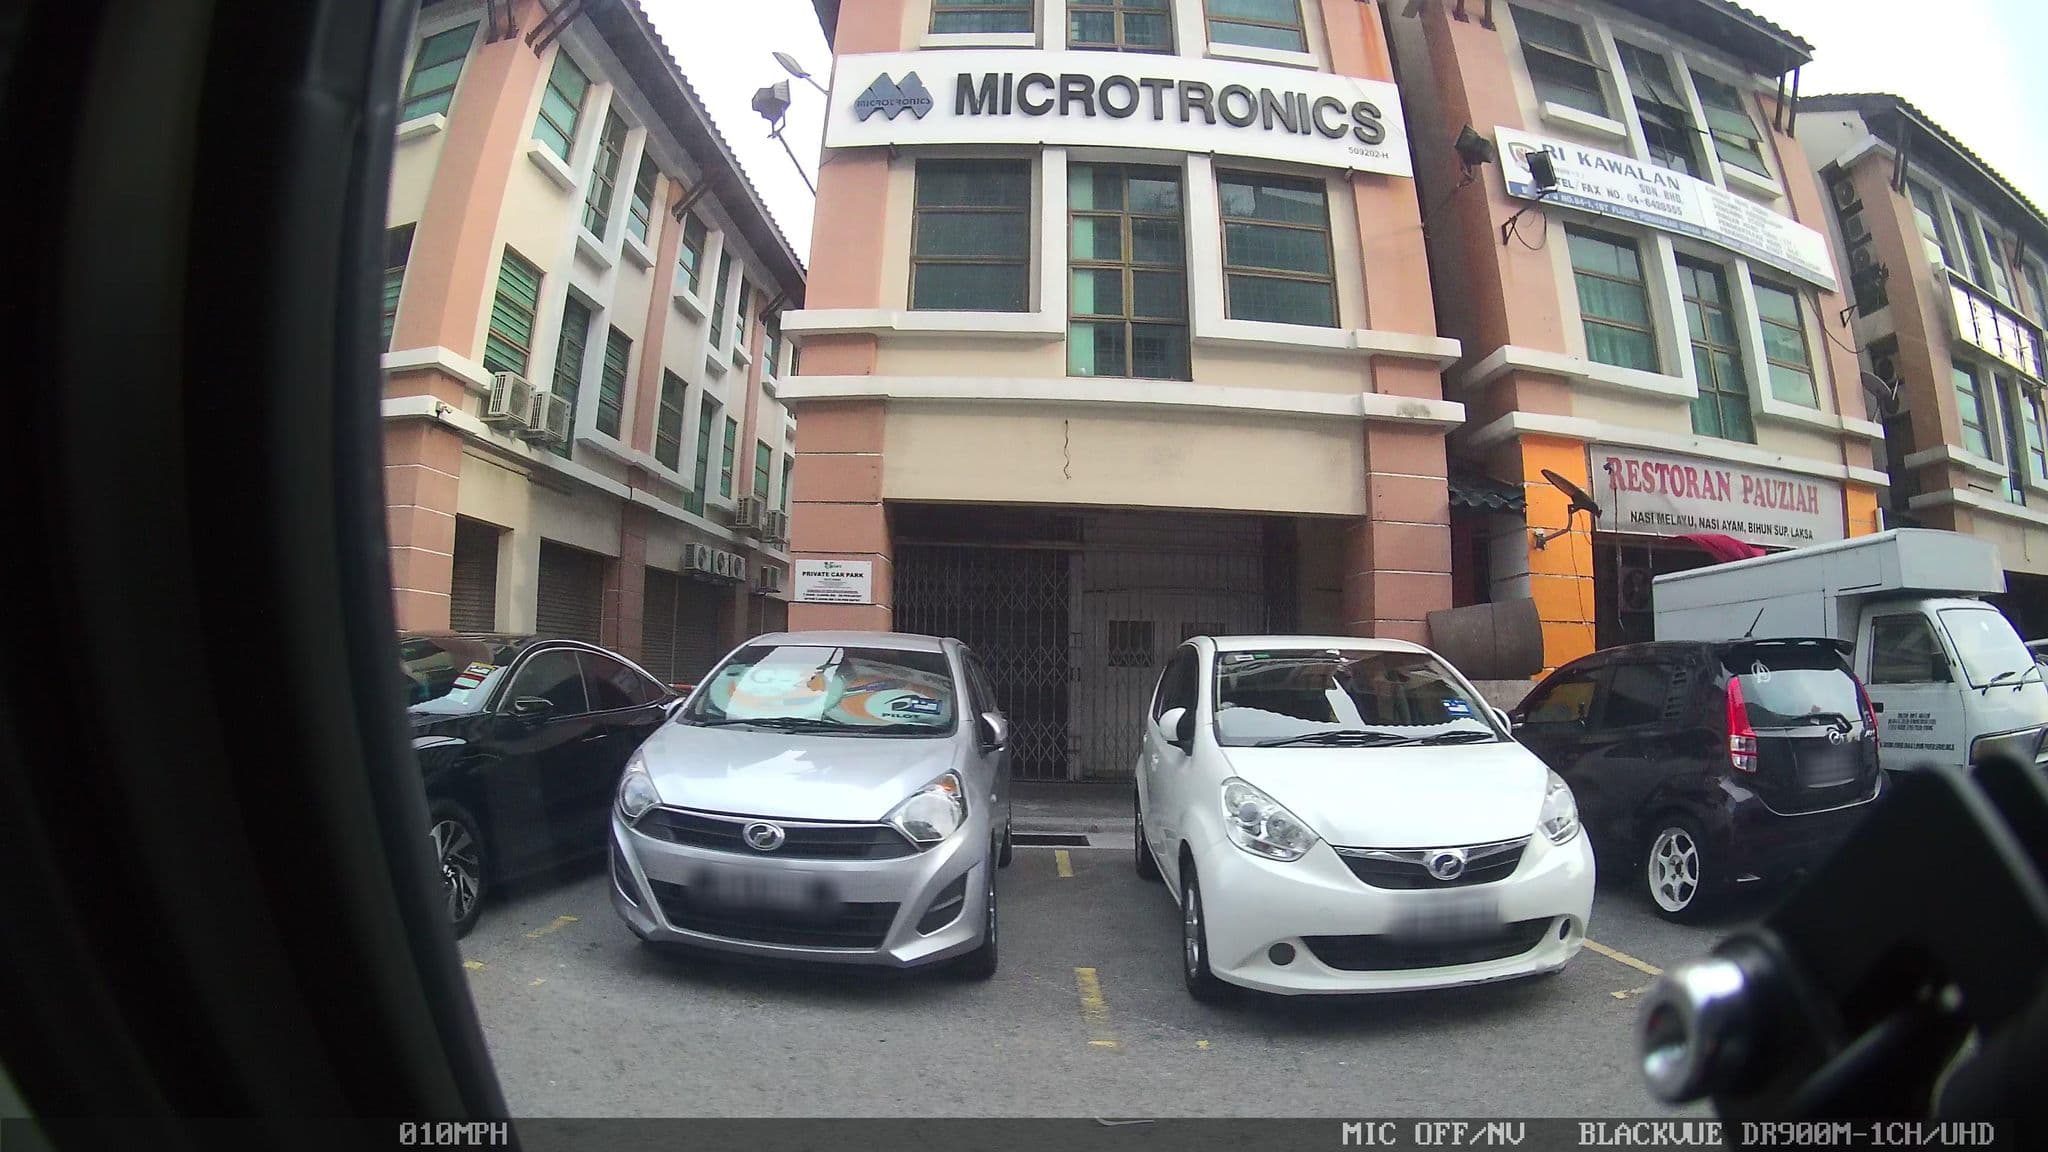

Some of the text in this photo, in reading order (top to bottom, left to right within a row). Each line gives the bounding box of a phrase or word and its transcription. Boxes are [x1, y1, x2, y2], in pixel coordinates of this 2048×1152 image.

[955, 71, 1387, 145] MICROTRONICS
[1577, 152, 1681, 190] KAWALAN
[1606, 456, 1819, 514] RESTORAN PAUZIAH
[1630, 511, 1654, 524] NASI
[1699, 517, 1720, 530] NASI
[1748, 522, 1772, 535] BIHUN
[1791, 527, 1814, 540] LAKSA
